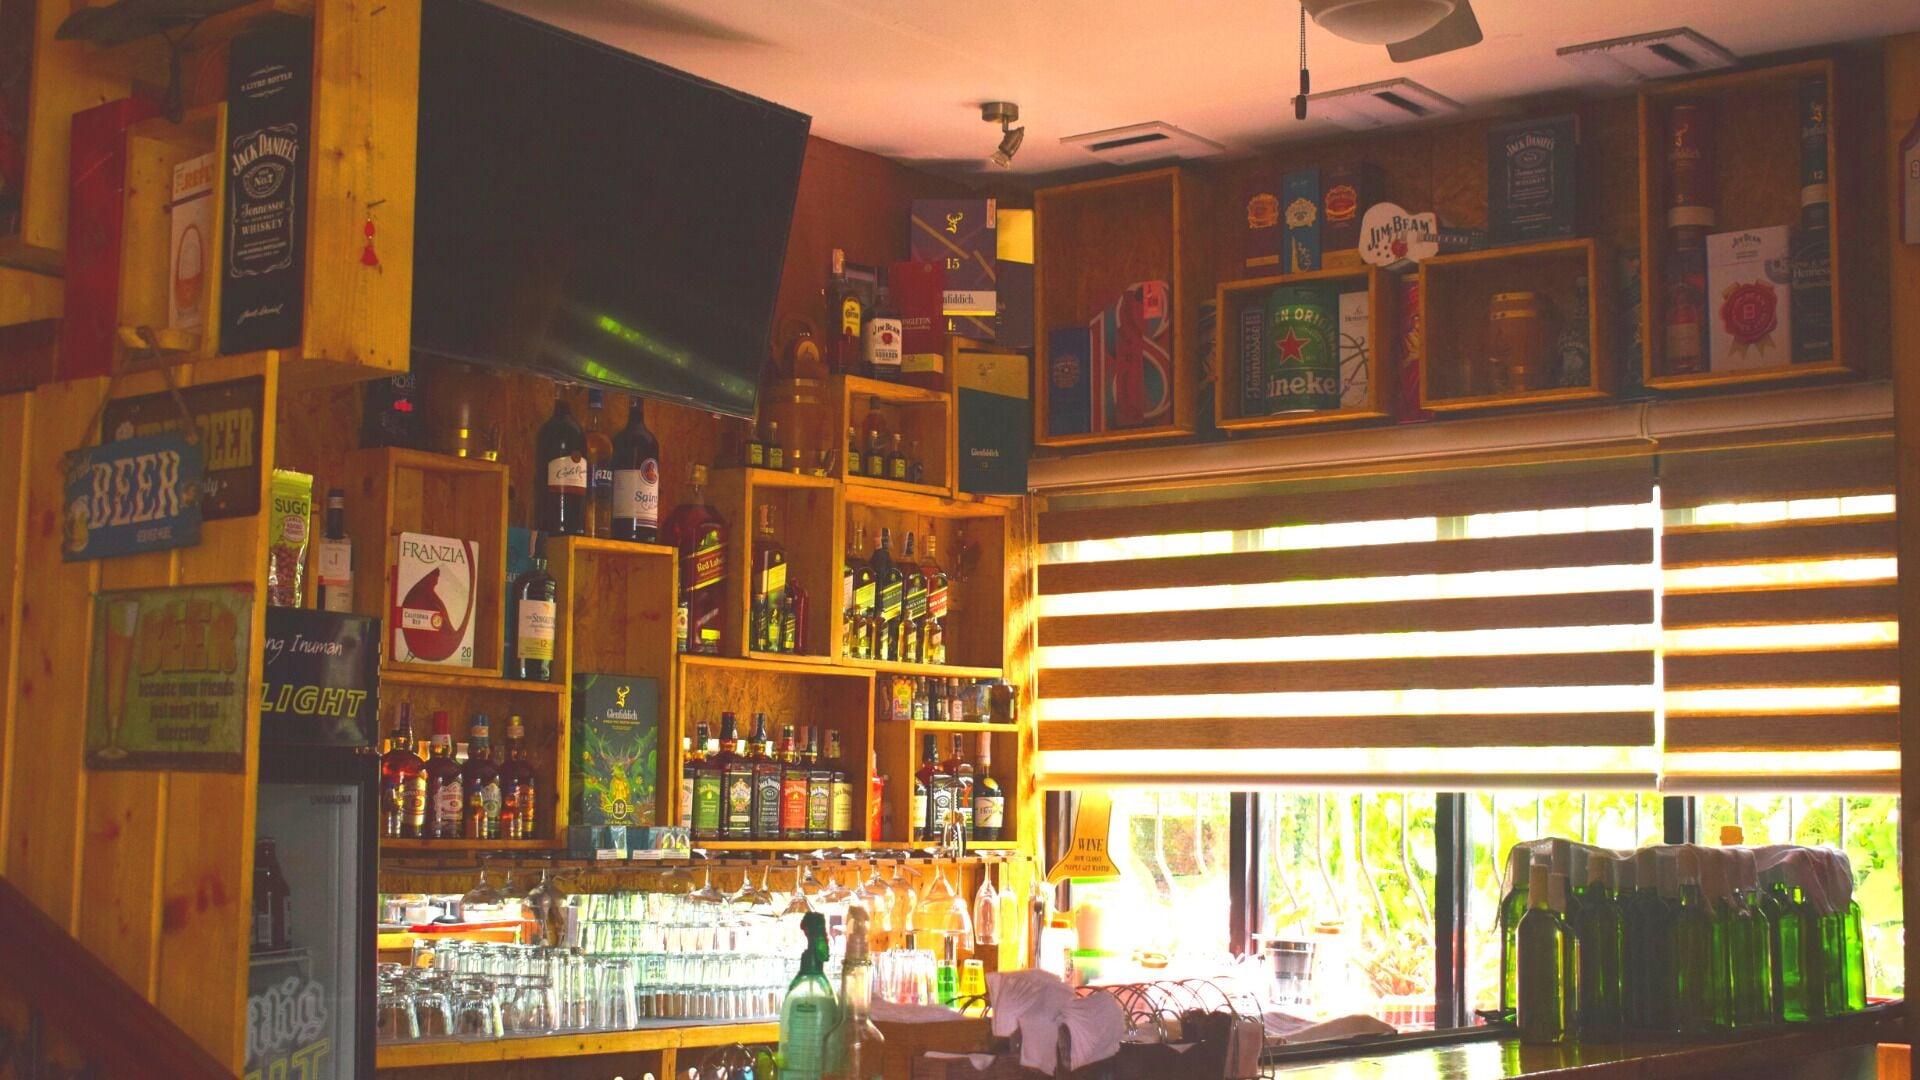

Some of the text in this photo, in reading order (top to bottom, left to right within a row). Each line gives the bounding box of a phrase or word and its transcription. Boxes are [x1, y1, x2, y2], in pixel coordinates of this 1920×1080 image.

[232, 133, 299, 177] JACK DANIEL'S
[241, 200, 286, 217] Tennessee
[241, 219, 283, 235] WHISKEY
[1367, 215, 1430, 251] JIM BEAM
[945, 257, 961, 270] 15
[943, 293, 974, 305] nfiddich
[1266, 371, 1338, 400] ineke
[88, 450, 180, 530] BEER
[402, 541, 466, 566] FRANZIA
[696, 562, 711, 575] Red
[289, 634, 344, 657] Inuman
[461, 646, 472, 658] 20
[539, 640, 548, 649] 12
[259, 682, 369, 719] LIGHT
[614, 802, 625, 815] 12
[1078, 837, 1104, 852] WINE
